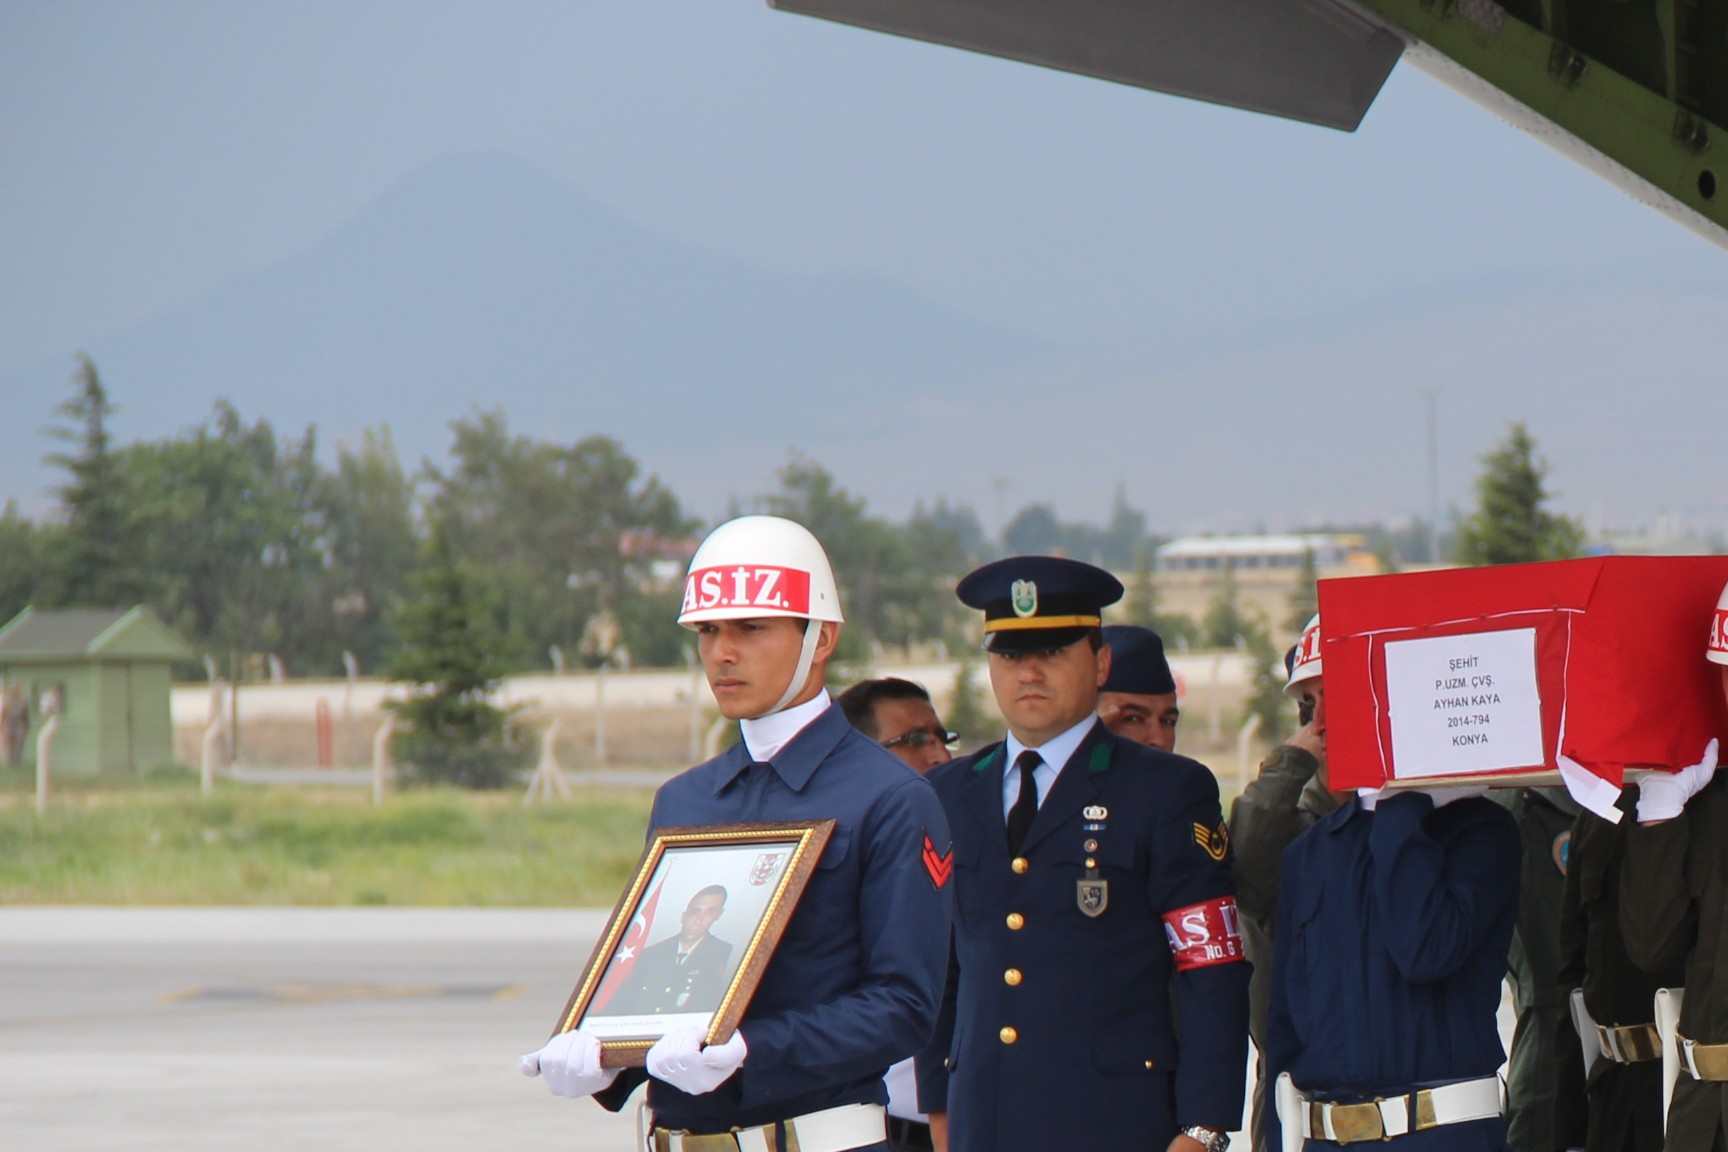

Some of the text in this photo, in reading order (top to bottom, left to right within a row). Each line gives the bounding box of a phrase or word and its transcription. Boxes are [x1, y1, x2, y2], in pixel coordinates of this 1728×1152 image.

[1449, 654, 1479, 672] ŞEHİT
[1433, 693, 1501, 710] AYHAN KAYA
[1447, 713, 1490, 728] 2014-794
[1451, 733, 1489, 746] KONYA
